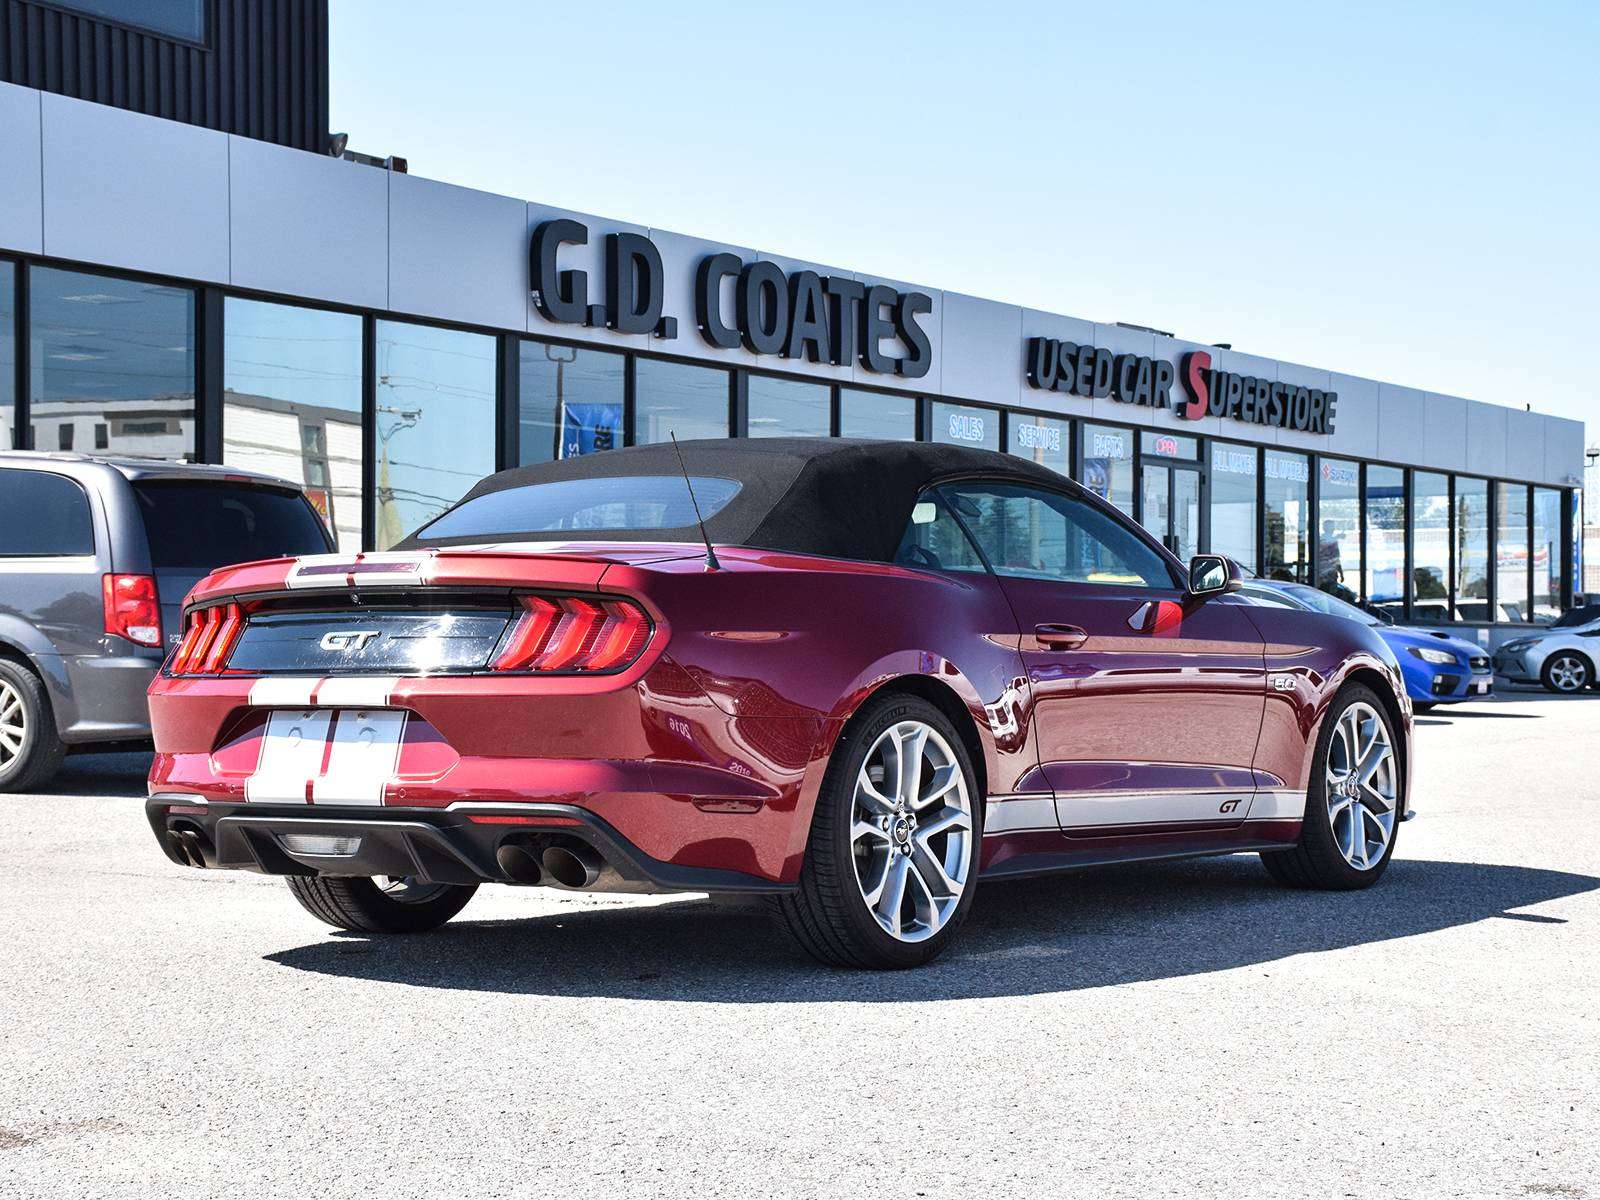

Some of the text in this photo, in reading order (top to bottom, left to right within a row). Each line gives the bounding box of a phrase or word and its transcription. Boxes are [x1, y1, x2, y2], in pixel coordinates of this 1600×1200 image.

[529, 218, 932, 379] G.D. COATES
[1027, 337, 1338, 435] USED CAR SUPERSTORE
[949, 414, 985, 442] SALES
[1018, 423, 1060, 451] SERVICE
[1093, 432, 1124, 458] PARTS
[1156, 438, 1177, 456] OPEN
[320, 631, 382, 651] GT
[1219, 799, 1242, 814] GT
